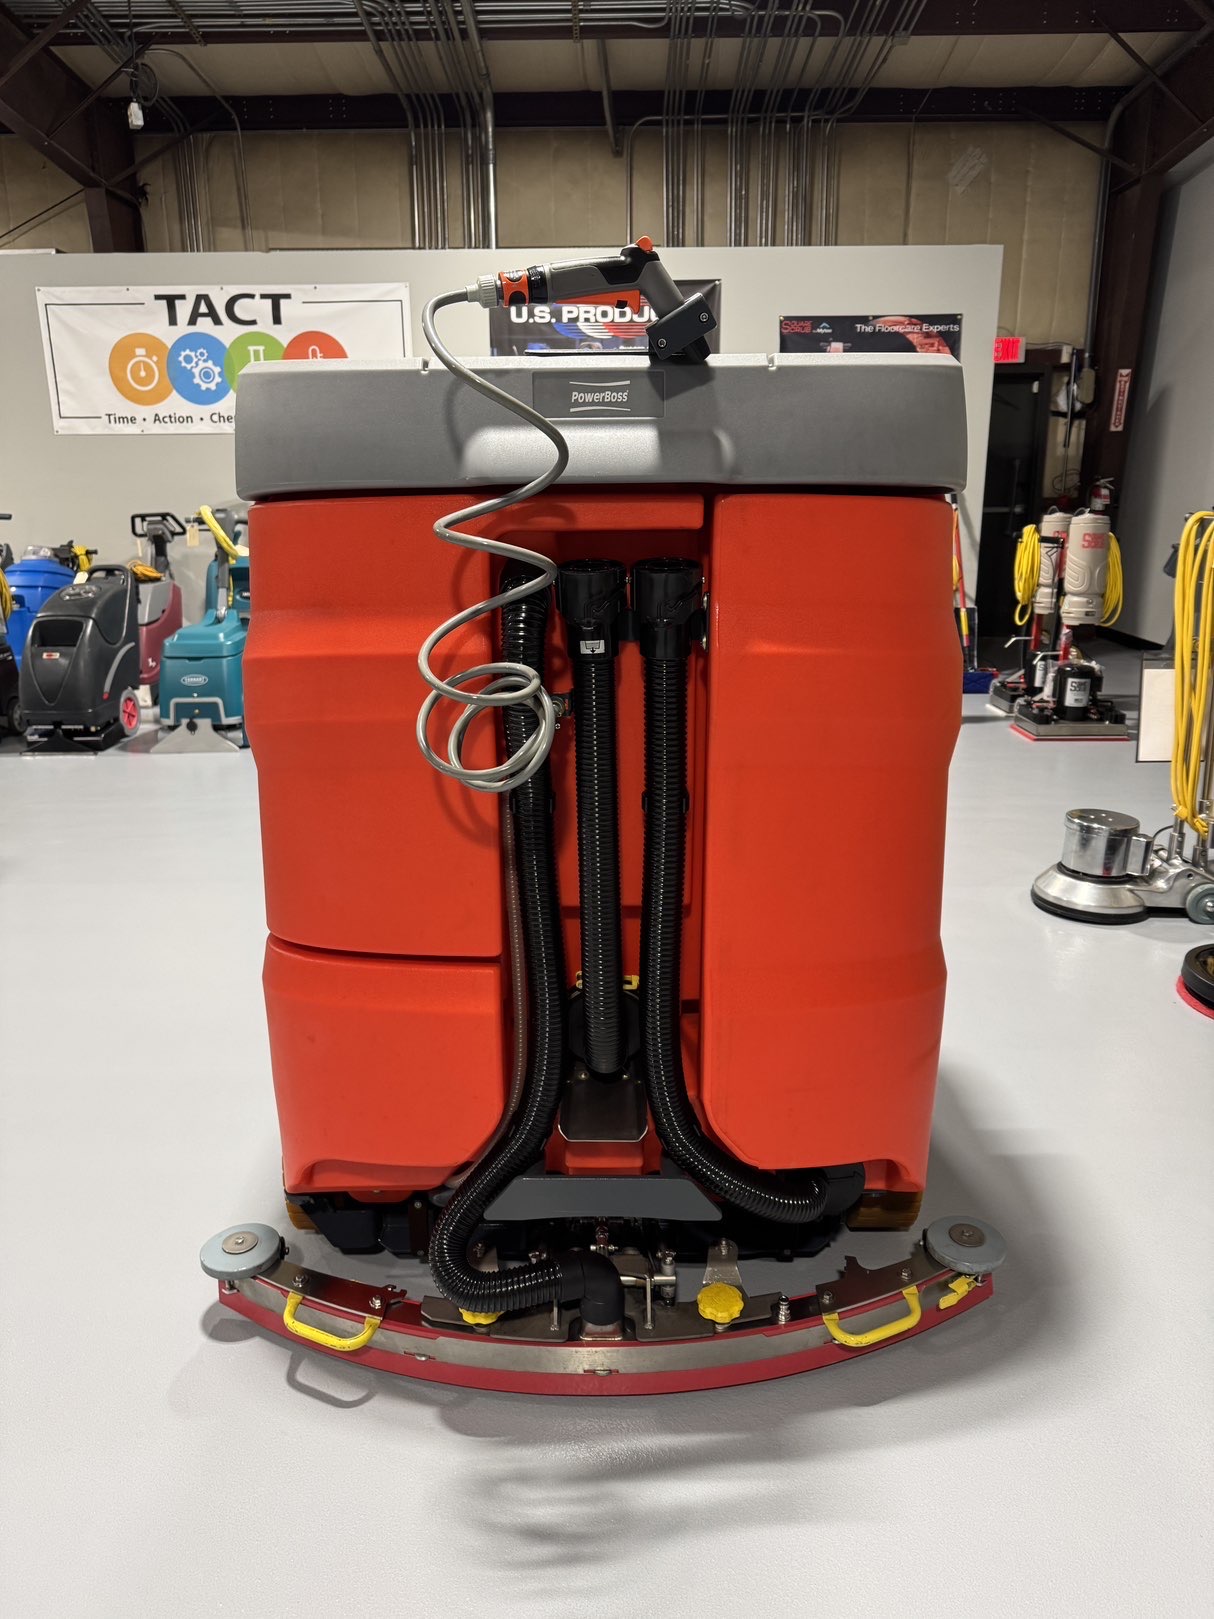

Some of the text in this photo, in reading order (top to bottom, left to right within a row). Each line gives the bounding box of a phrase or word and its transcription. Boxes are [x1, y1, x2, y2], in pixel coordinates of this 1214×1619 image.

[154, 293, 292, 326] TACT
[510, 305, 556, 323] U.S.
[855, 323, 960, 333] The Floorcare Experts
[993, 337, 1021, 361] EXIT
[571, 390, 628, 403] PowerBoss
[105, 411, 235, 424] Time Action Che
